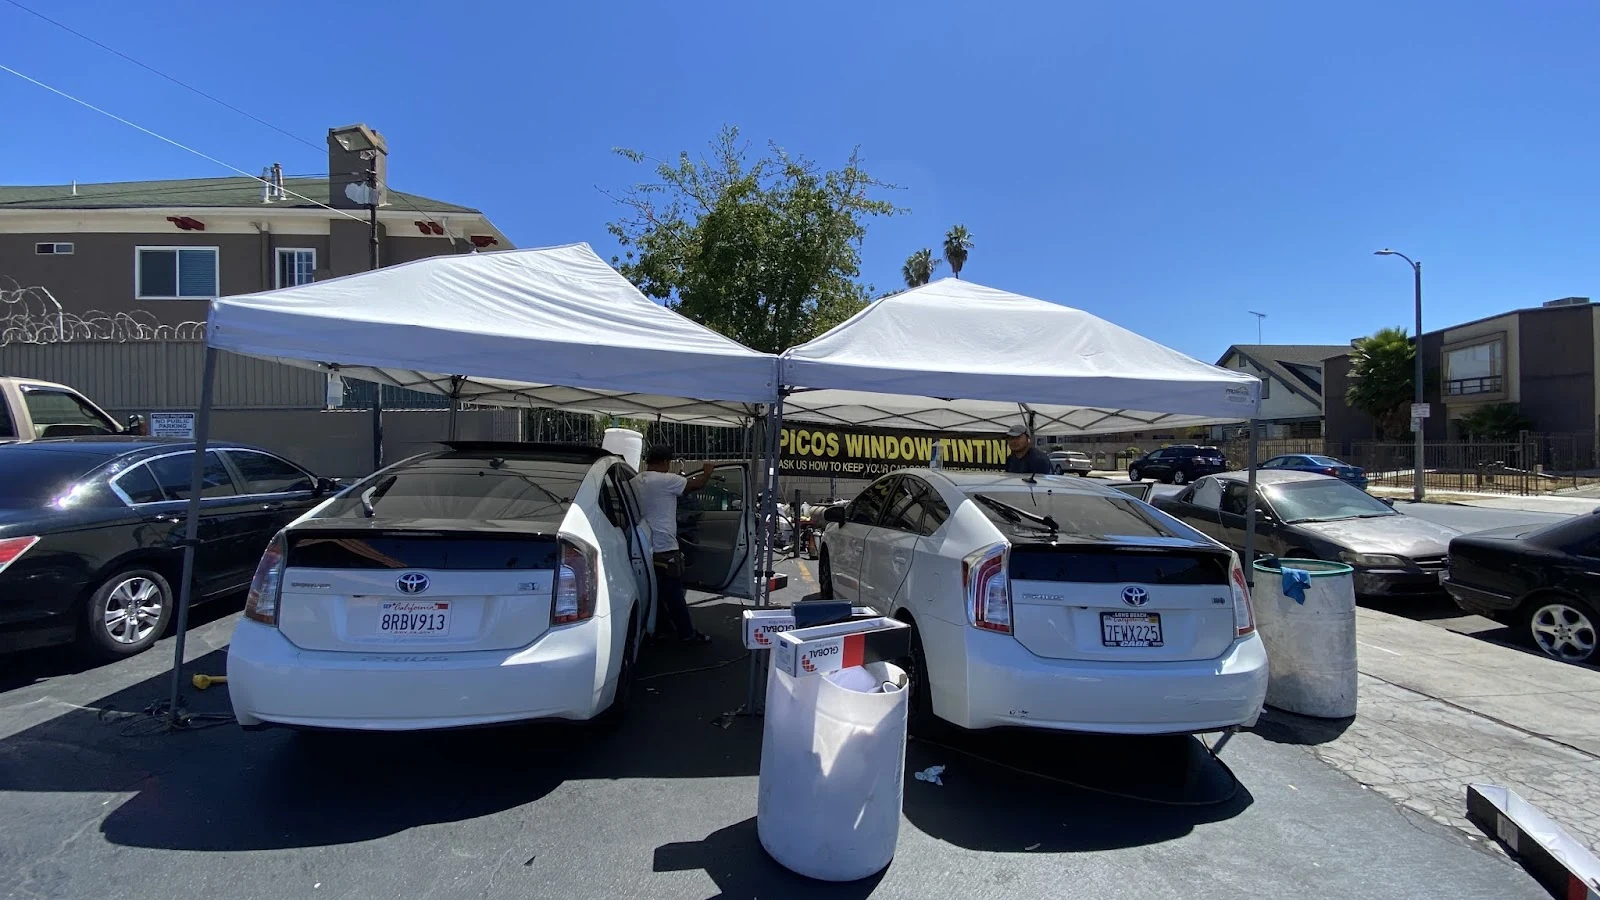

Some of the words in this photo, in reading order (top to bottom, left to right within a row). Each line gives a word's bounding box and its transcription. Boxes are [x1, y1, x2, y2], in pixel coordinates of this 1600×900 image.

[780, 429, 839, 457] PICOS
[845, 434, 932, 460] WINDOW
[938, 438, 1011, 465] TINTIN
[779, 460, 794, 469] ASK
[796, 460, 807, 470] US
[809, 461, 829, 471] HOW
[830, 462, 841, 471] TO
[843, 462, 864, 473] KEEP
[866, 463, 888, 474] YOUR
[393, 602, 434, 613] California
[381, 614, 445, 630] 8RBV913
[761, 624, 796, 633] GLOBAL
[809, 645, 839, 658] GLOBAL
